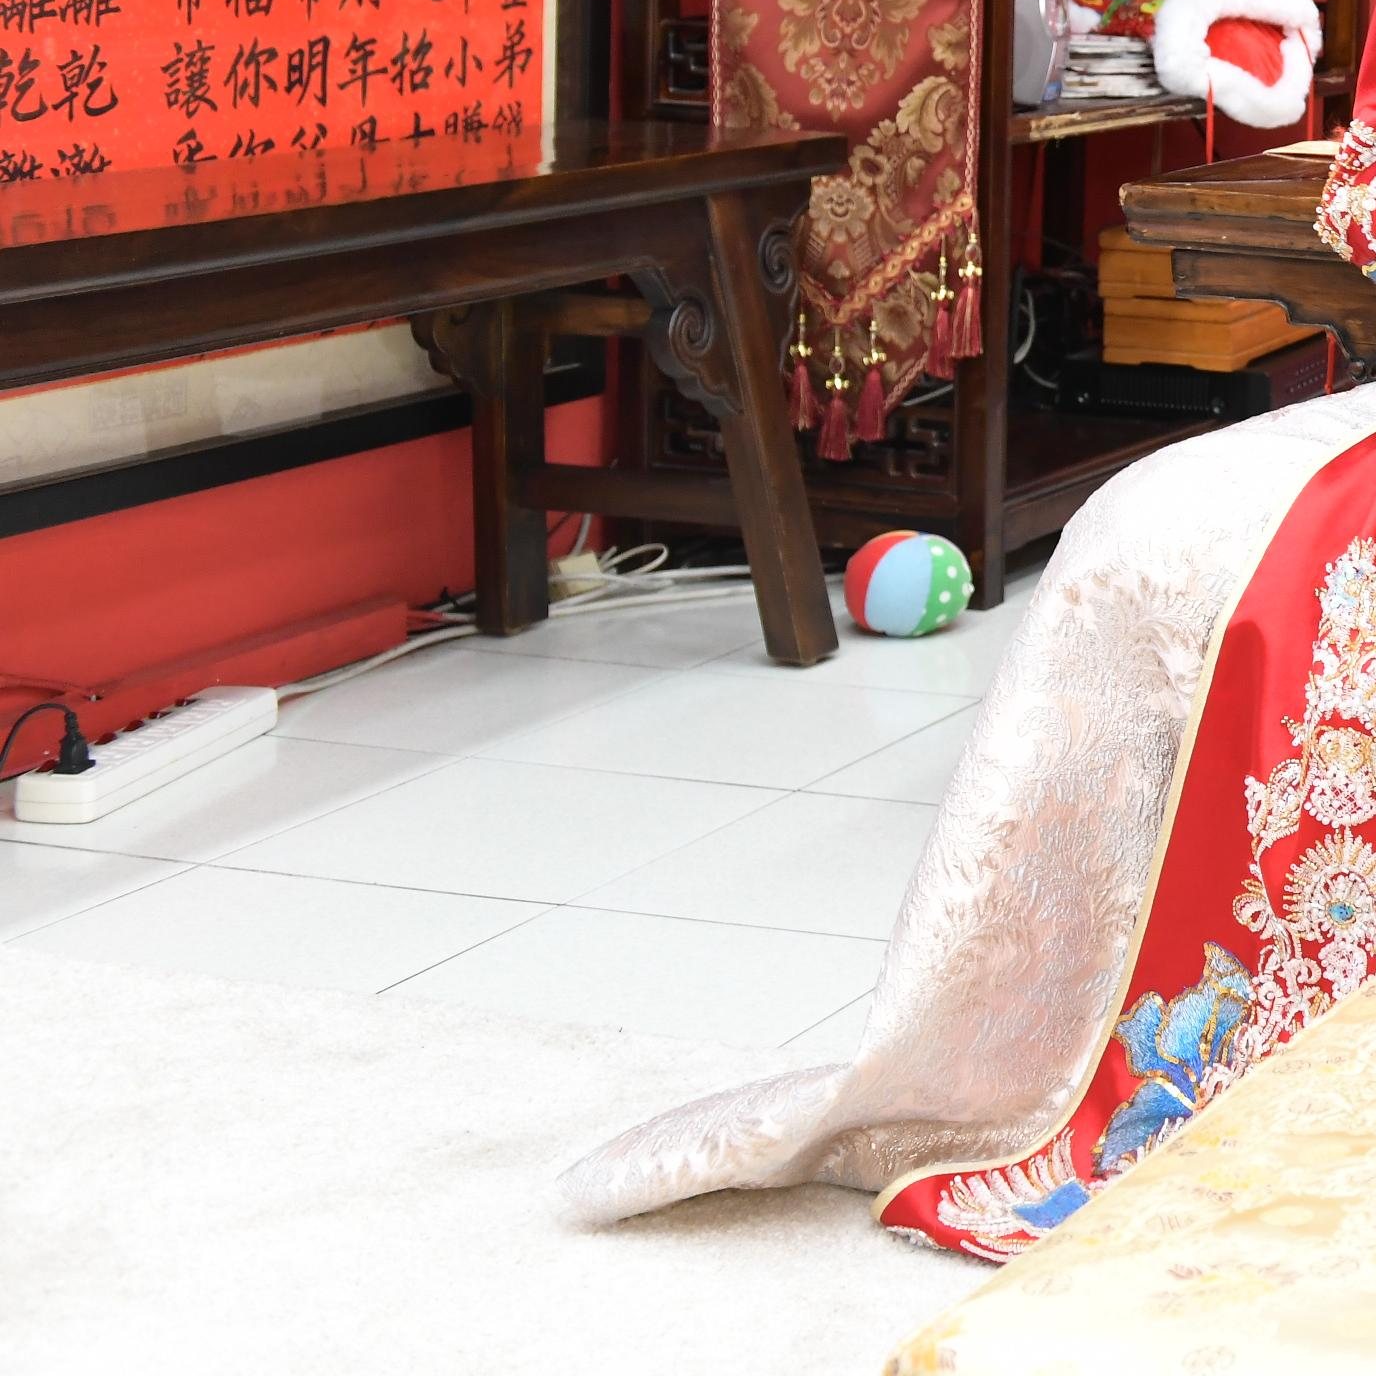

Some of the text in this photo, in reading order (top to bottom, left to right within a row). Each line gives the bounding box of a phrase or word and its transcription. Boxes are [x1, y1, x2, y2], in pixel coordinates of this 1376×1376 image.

[161, 19, 533, 118] 讓你明年招小弟
